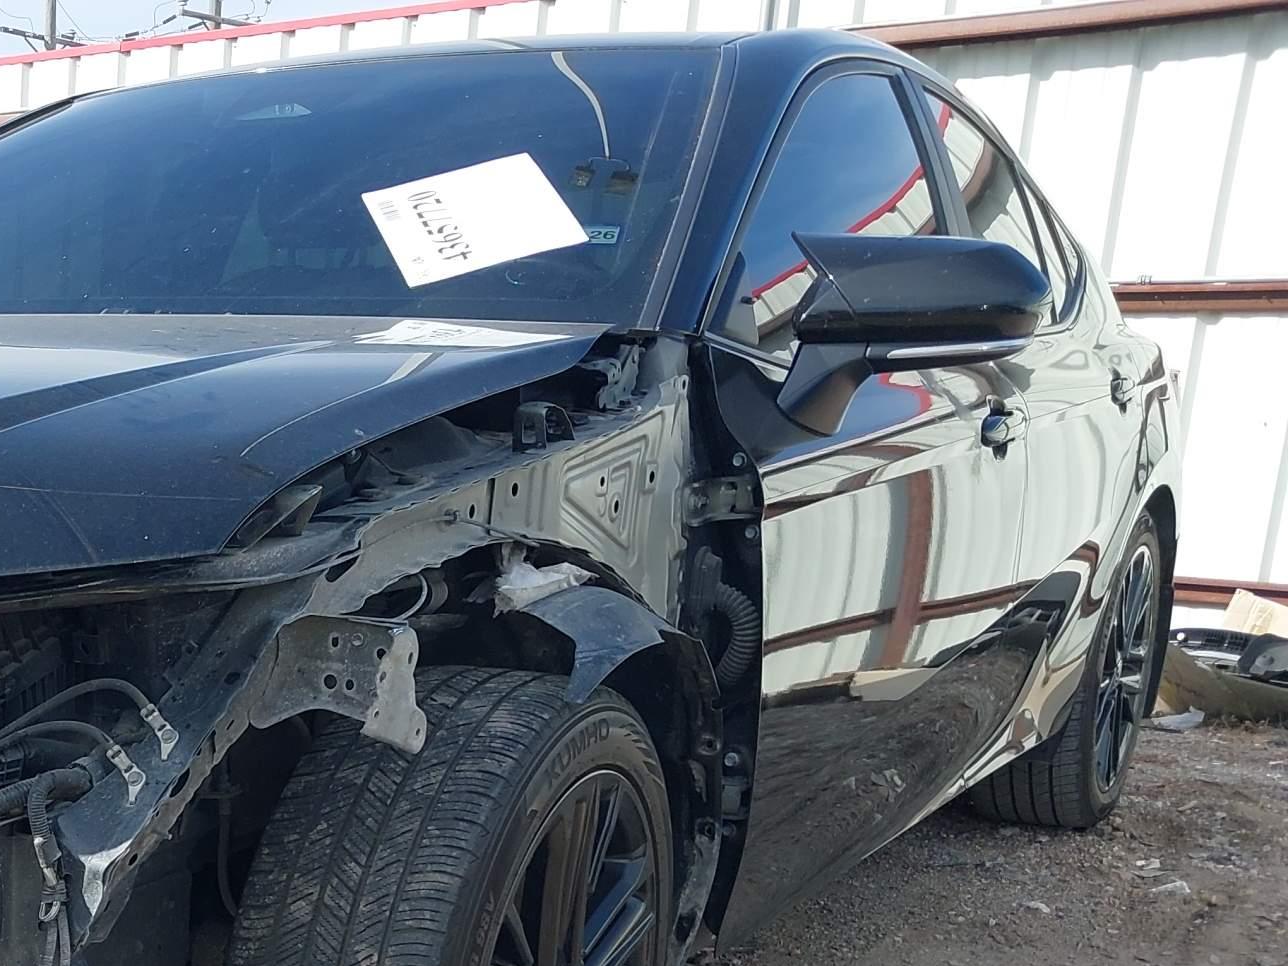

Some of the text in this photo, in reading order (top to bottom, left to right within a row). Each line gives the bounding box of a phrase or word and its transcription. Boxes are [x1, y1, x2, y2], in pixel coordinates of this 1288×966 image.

[407, 190, 473, 261] 43657720
[590, 230, 616, 240] 26
[544, 717, 610, 789] KUMHO
